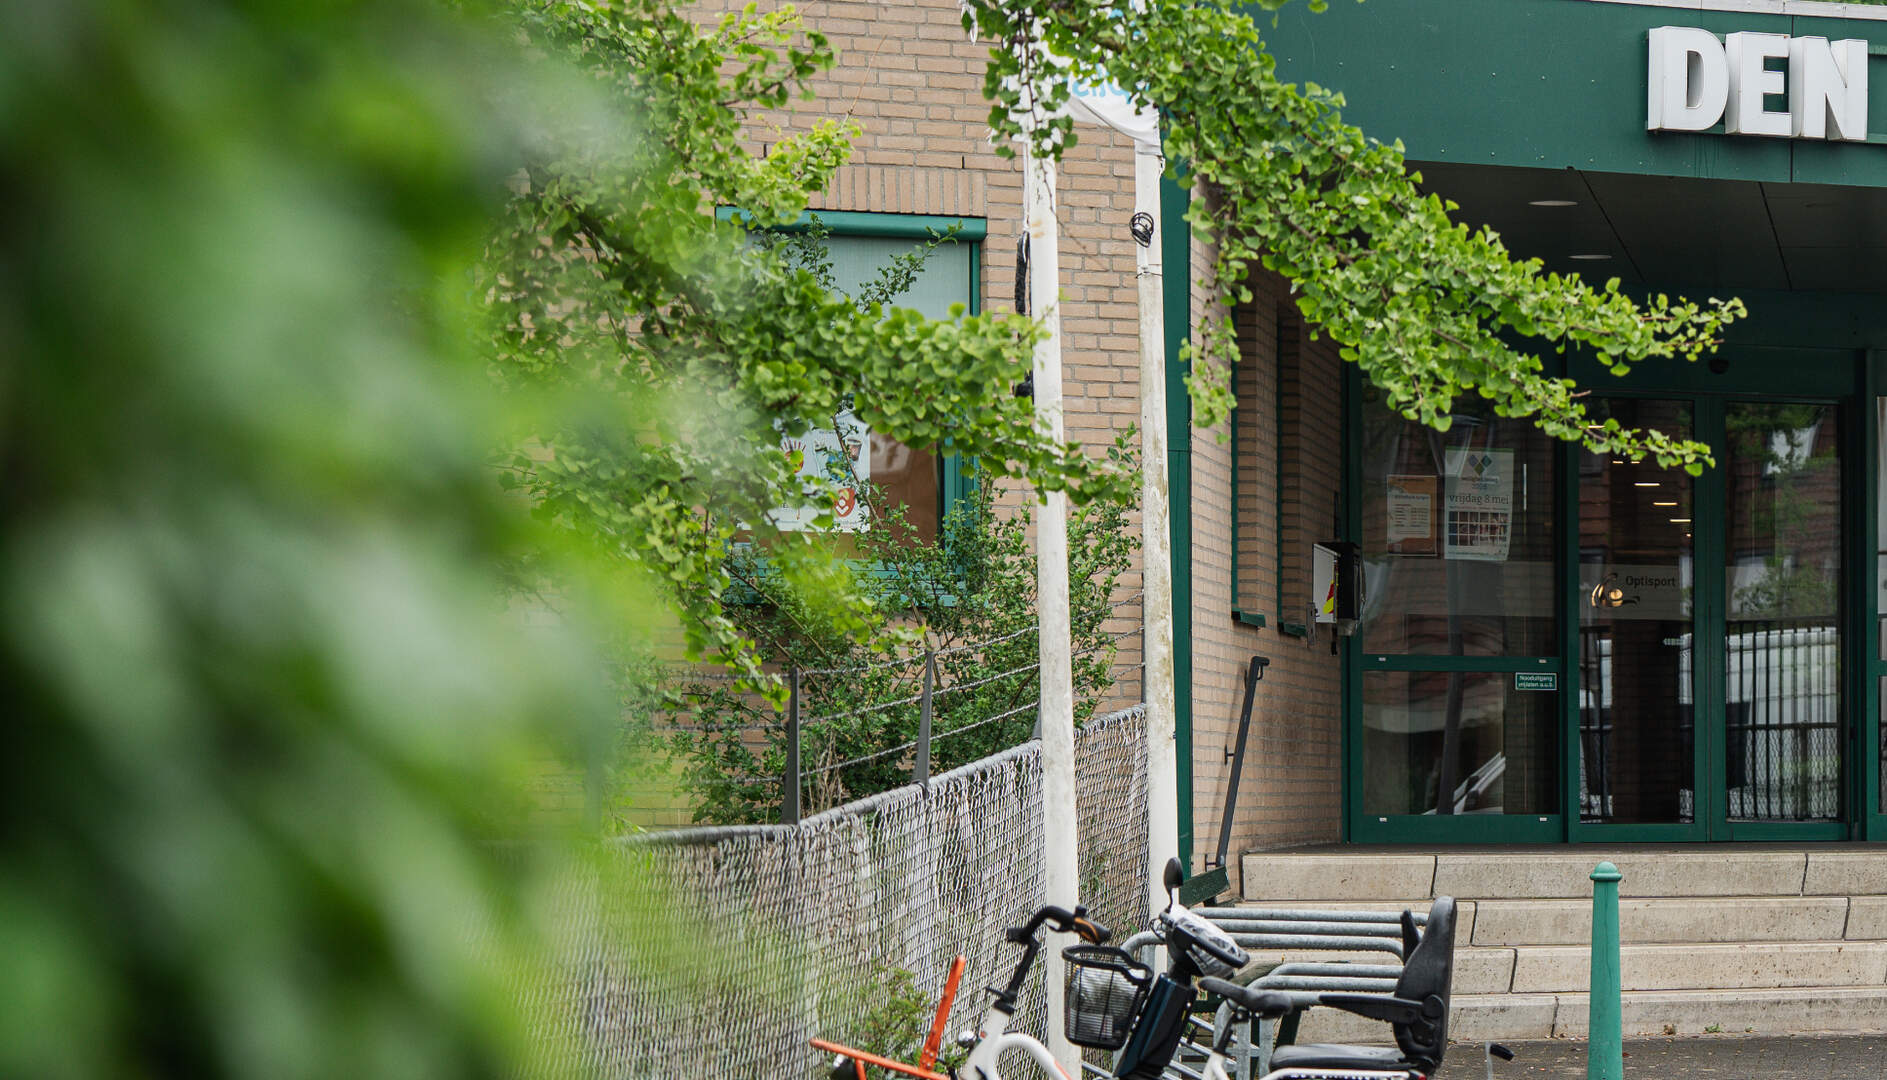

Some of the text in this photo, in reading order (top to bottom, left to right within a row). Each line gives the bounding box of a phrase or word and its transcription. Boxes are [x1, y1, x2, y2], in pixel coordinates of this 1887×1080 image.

[1646, 25, 1868, 141] DEN
[1449, 493, 1482, 505] vrijdag
[1492, 495, 1510, 505] mei
[1625, 575, 1676, 588] Optisport
